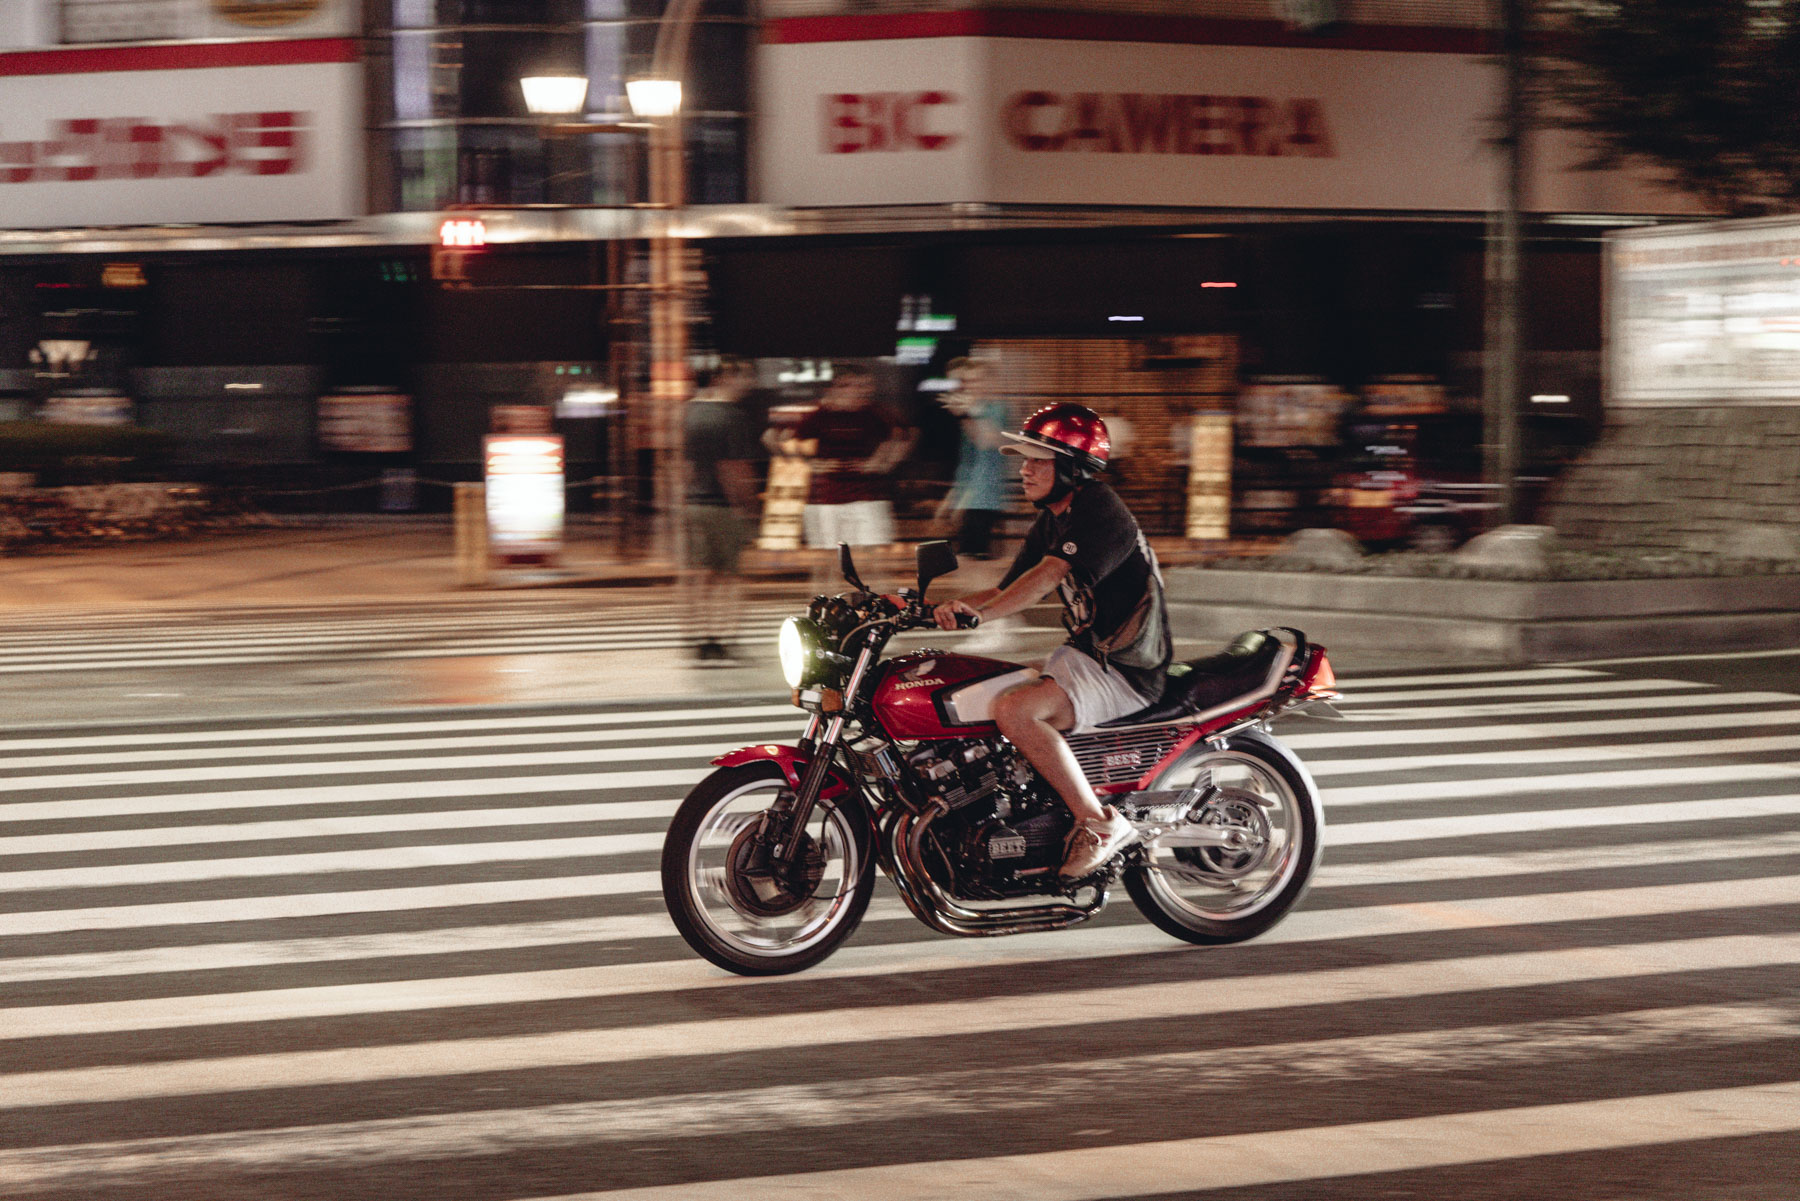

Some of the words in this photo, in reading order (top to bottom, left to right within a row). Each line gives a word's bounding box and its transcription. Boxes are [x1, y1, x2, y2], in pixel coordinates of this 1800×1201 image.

[820, 91, 959, 154] BIC
[1003, 91, 1338, 158] CAMERA
[895, 678, 945, 690] HONDA
